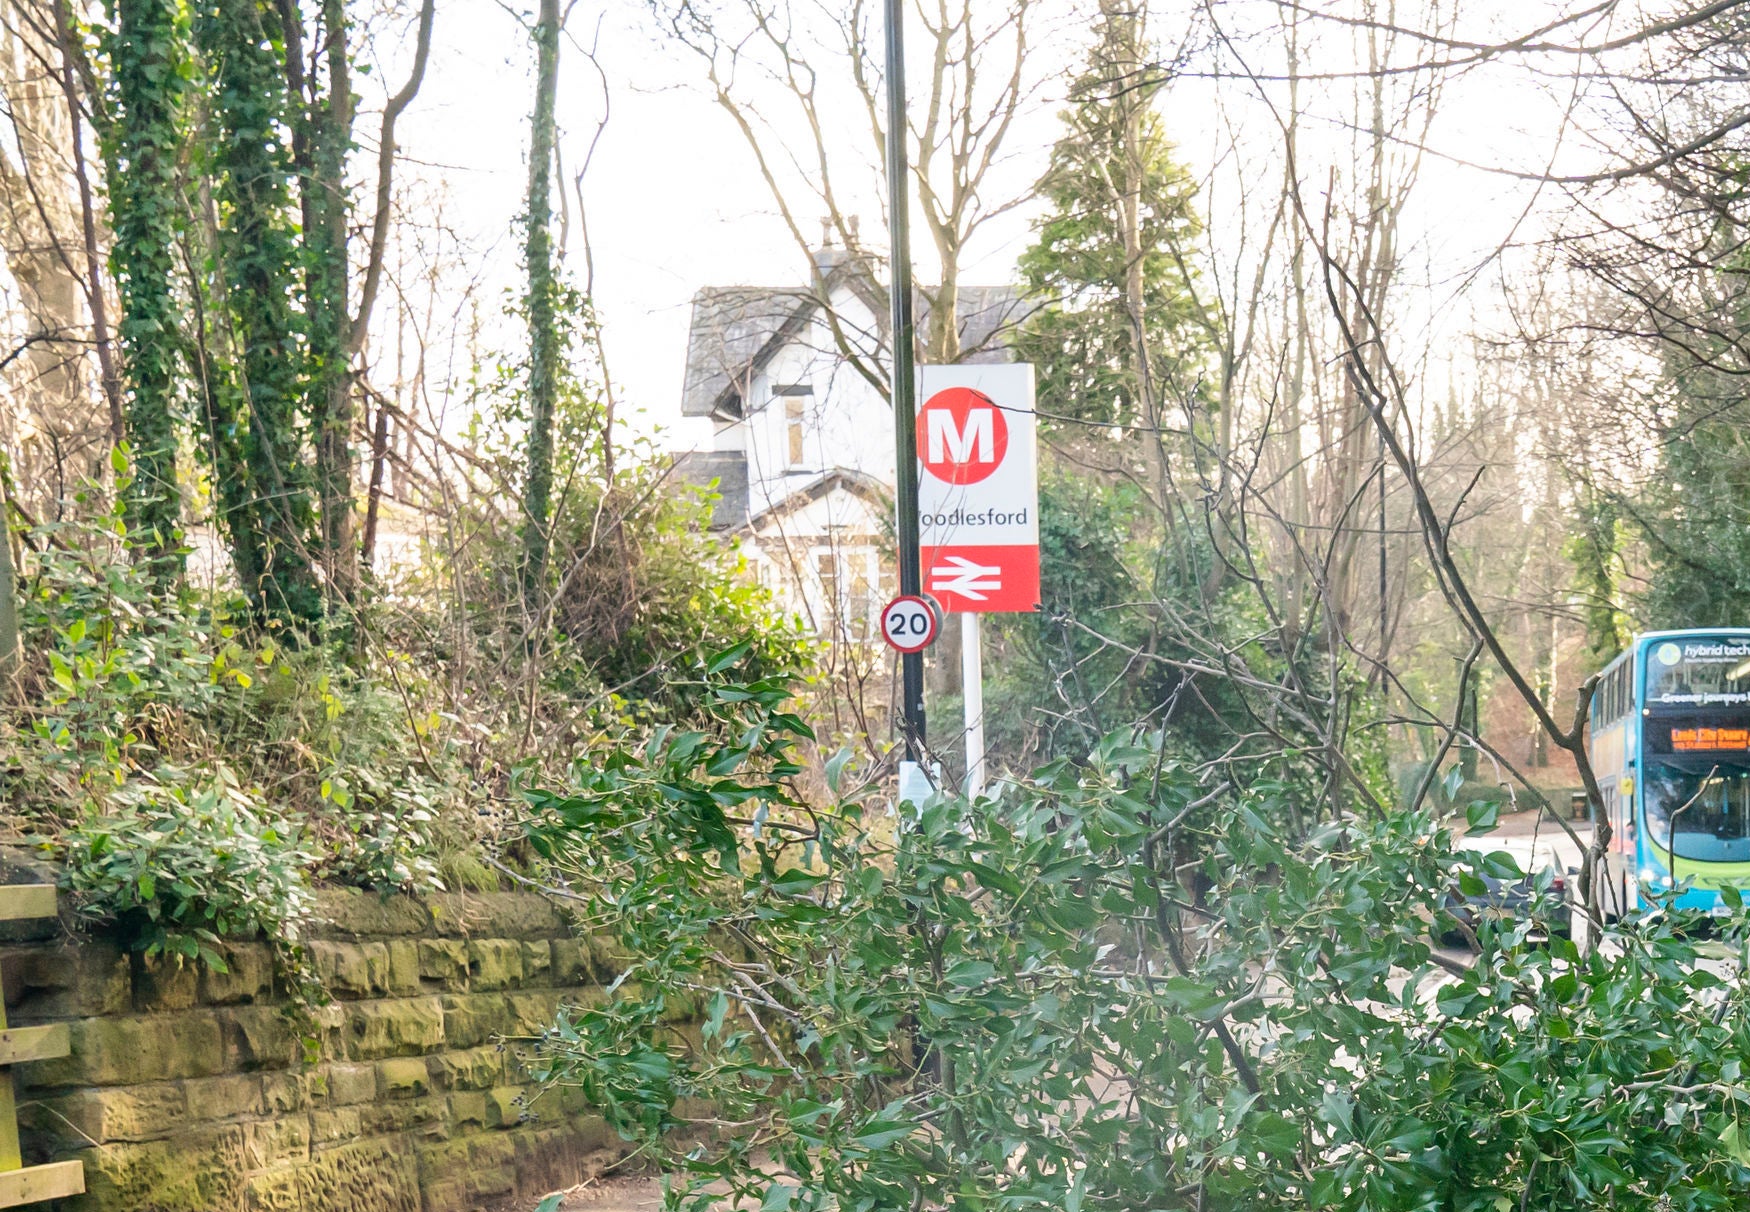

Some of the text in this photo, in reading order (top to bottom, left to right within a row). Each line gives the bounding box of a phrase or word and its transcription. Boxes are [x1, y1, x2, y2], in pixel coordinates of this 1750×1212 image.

[927, 408, 994, 464] M
[917, 507, 1027, 526] oodlesford
[889, 612, 928, 635] 20
[1685, 644, 1722, 658] hybrid
[1660, 693, 1703, 703] Greener
[1703, 693, 1746, 704] journeys
